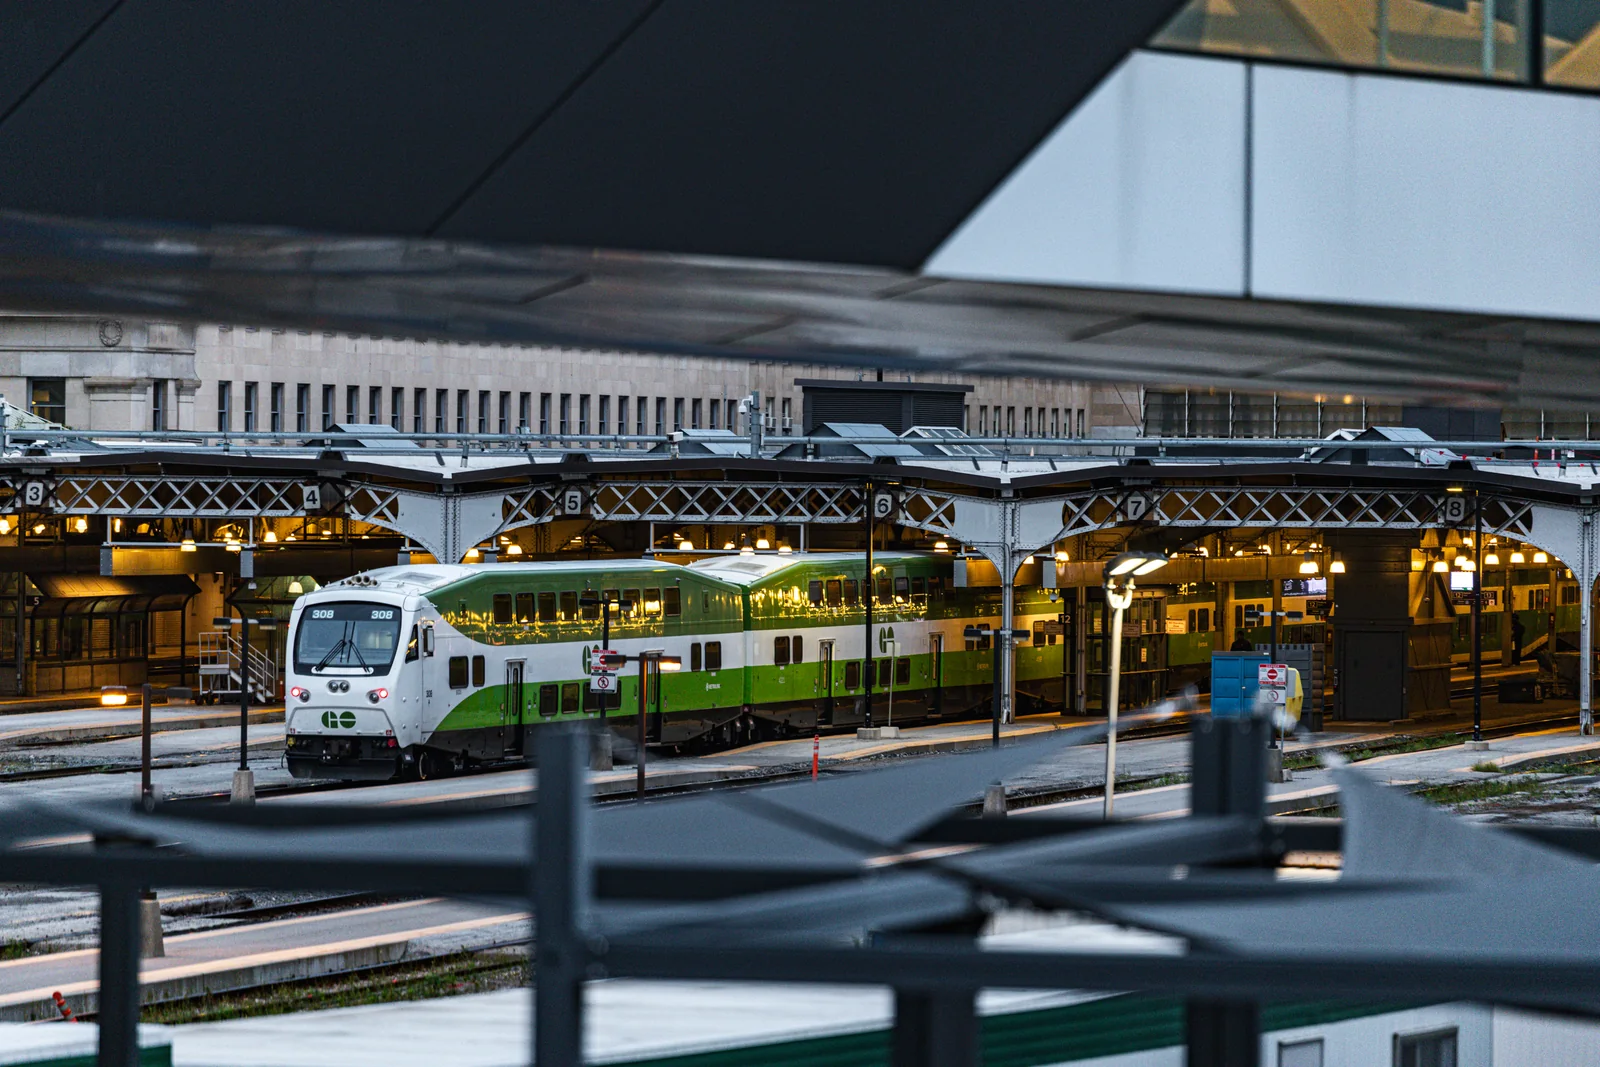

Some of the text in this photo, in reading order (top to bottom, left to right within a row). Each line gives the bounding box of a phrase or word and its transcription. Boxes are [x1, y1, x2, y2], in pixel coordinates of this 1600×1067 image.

[29, 486, 40, 501] 3
[306, 490, 318, 505] 4
[567, 495, 578, 510] 5
[877, 498, 889, 514] 6
[1131, 500, 1142, 516] 7
[1450, 501, 1461, 517] 8
[33, 596, 40, 606] 5
[312, 609, 335, 619] 308
[371, 610, 394, 620] 308
[1060, 614, 1071, 624] 12
[321, 711, 357, 729] GO
